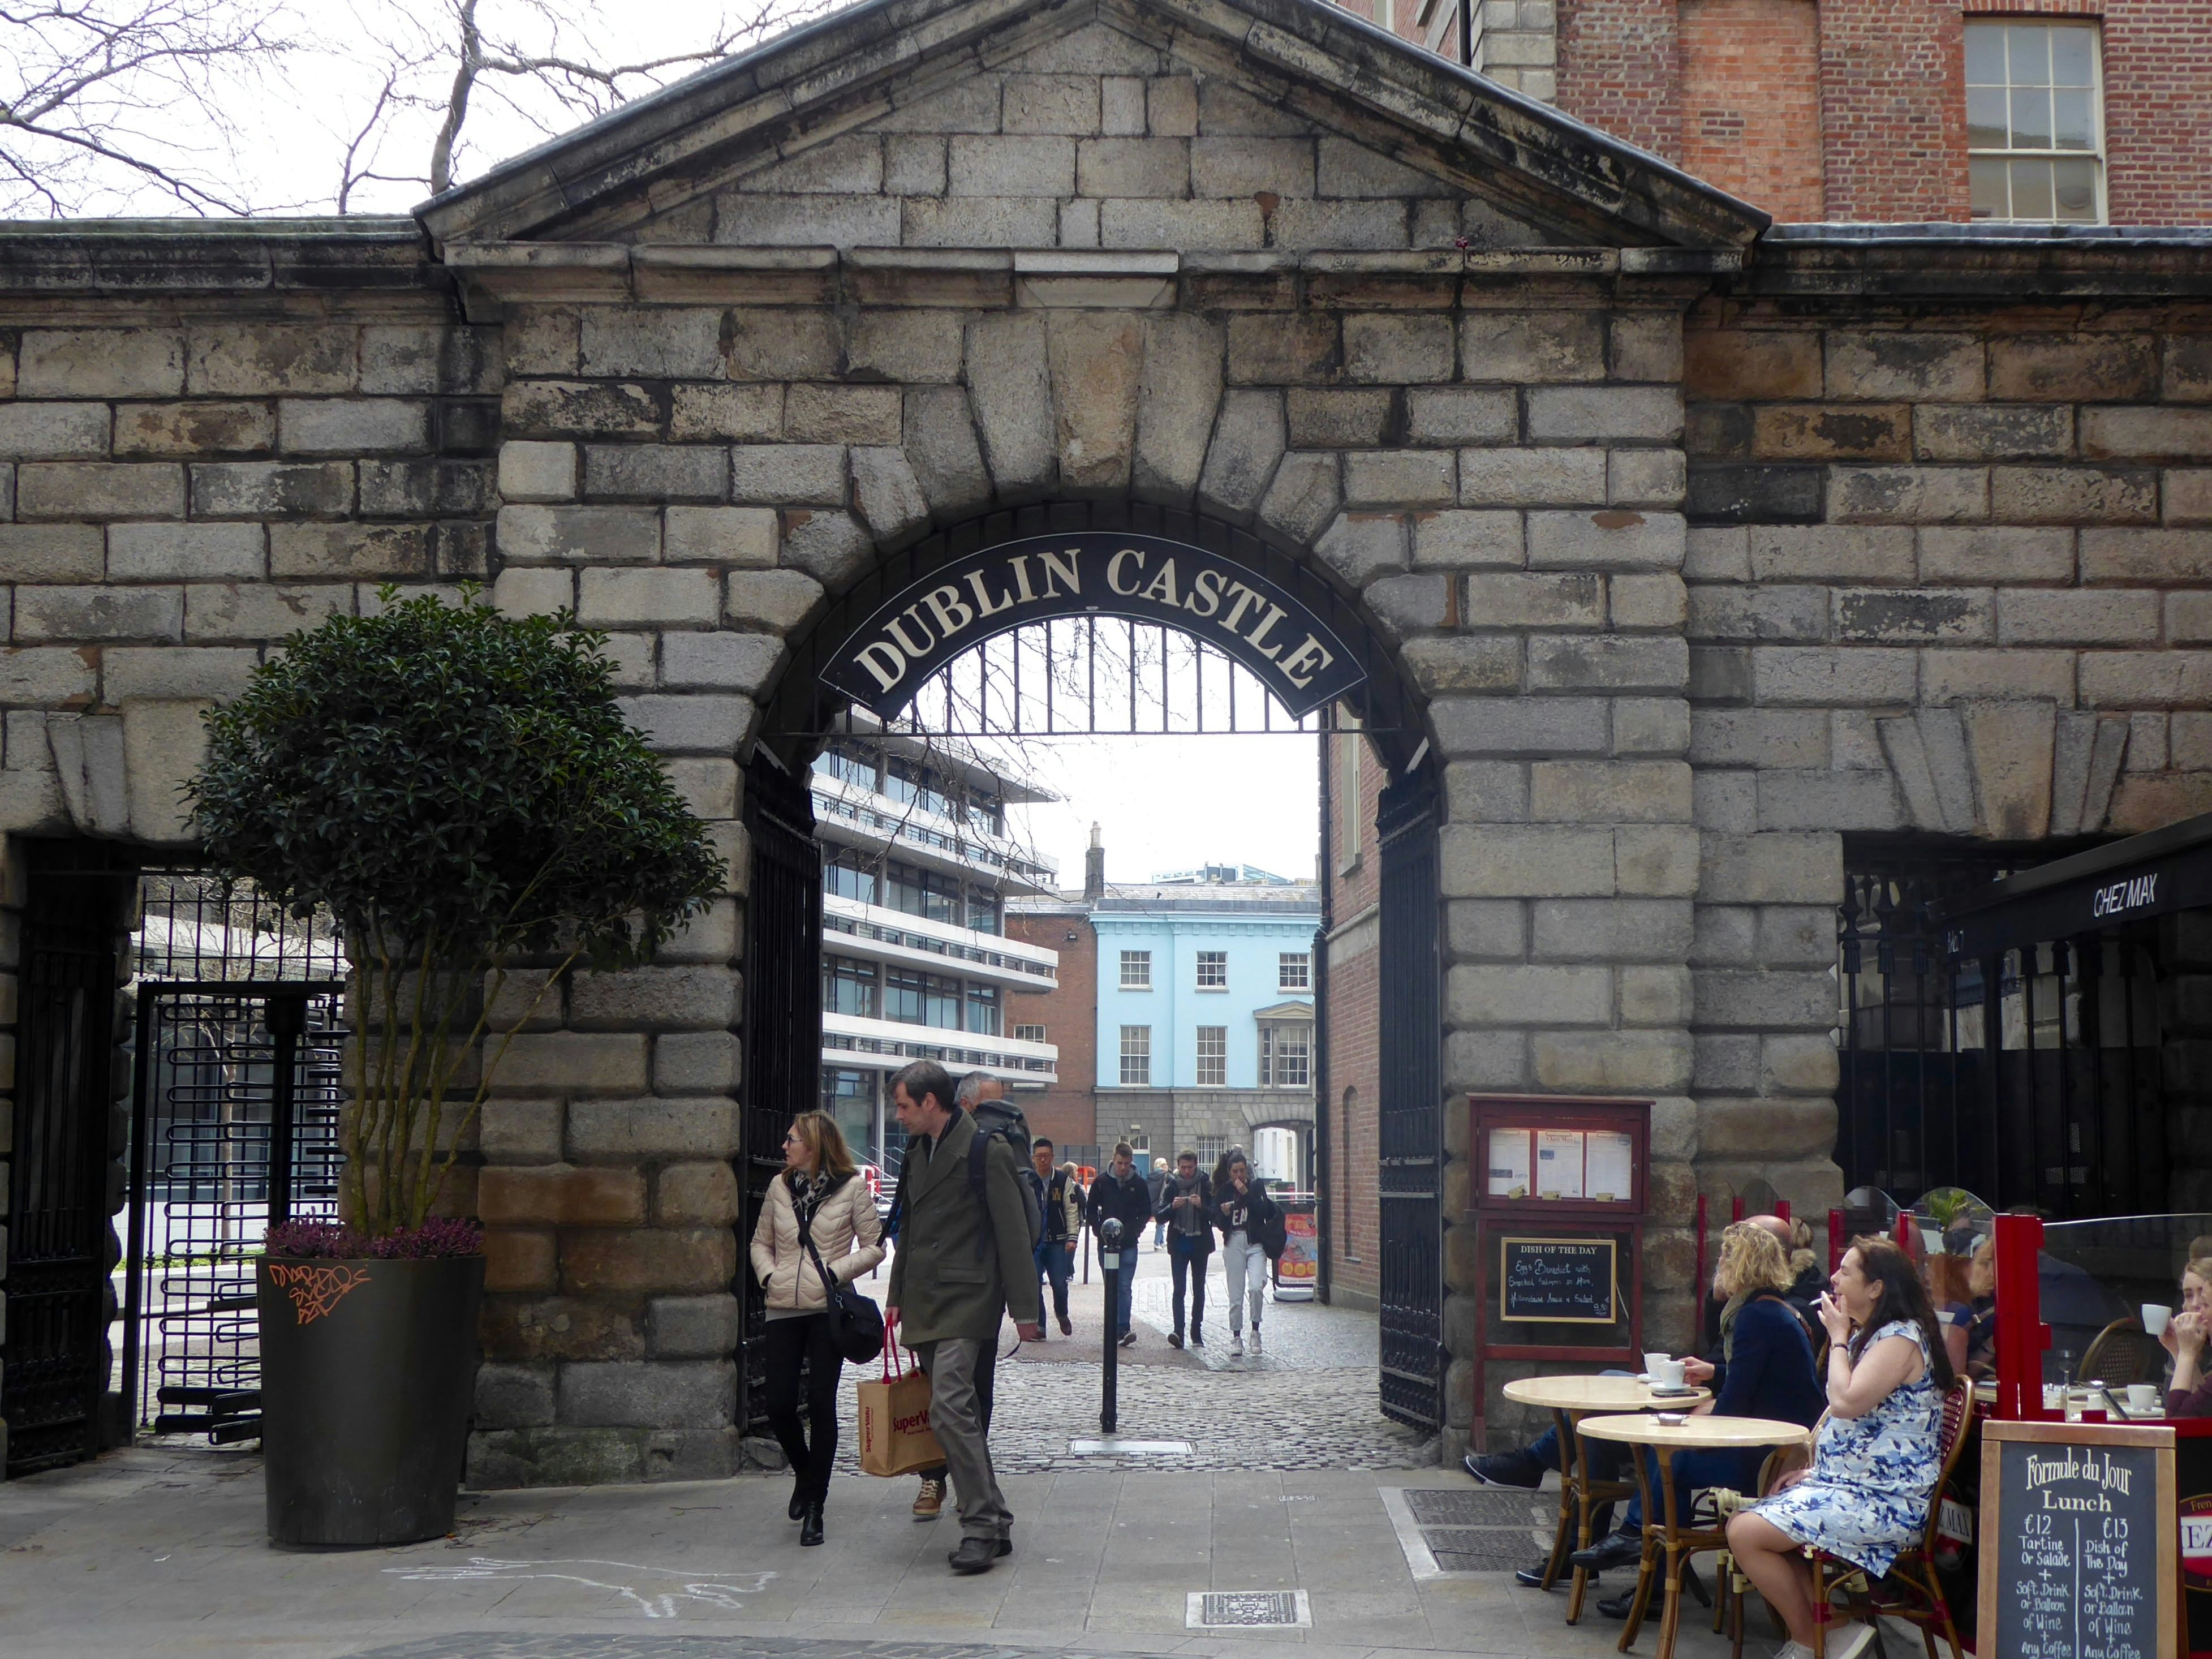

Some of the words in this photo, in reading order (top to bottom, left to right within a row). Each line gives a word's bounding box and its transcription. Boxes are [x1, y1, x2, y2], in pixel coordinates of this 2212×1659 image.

[853, 548, 1082, 694] DUBLIN
[1107, 549, 1335, 690] CASTLE
[2094, 882, 2127, 917] CHEZ
[2126, 873, 2158, 908] MAX
[893, 1409, 931, 1434] SuperV
[2026, 1446, 2080, 1490] Formule
[2082, 1449, 2100, 1481] du
[2102, 1452, 2132, 1495] Jour
[2042, 1490, 2112, 1512] Lunch
[2024, 1514, 2051, 1535] €12
[2103, 1517, 2128, 1538] €13
[2018, 1536, 2064, 1550] Tartine
[2085, 1539, 2111, 1554] Dish
[2114, 1541, 2128, 1558] of
[2036, 1551, 2071, 1567] Salade
[2083, 1554, 2103, 1568] The
[2106, 1555, 2127, 1578] Day
[2016, 1580, 2039, 1600] Soft
[2084, 1582, 2108, 1603] Soft
[2033, 1597, 2067, 1612] Balloon
[2098, 1601, 2134, 1616] Balloon
[2023, 1613, 2035, 1632] of
[2036, 1614, 2063, 1631] Wine
[2088, 1617, 2101, 1638] of
[2105, 1617, 2132, 1635] Wine
[2021, 1641, 2040, 1659] Any
[2042, 1640, 2072, 1659] Coffee
[2085, 1644, 2105, 1659] Any
[2106, 1643, 2141, 1659] Coffee
